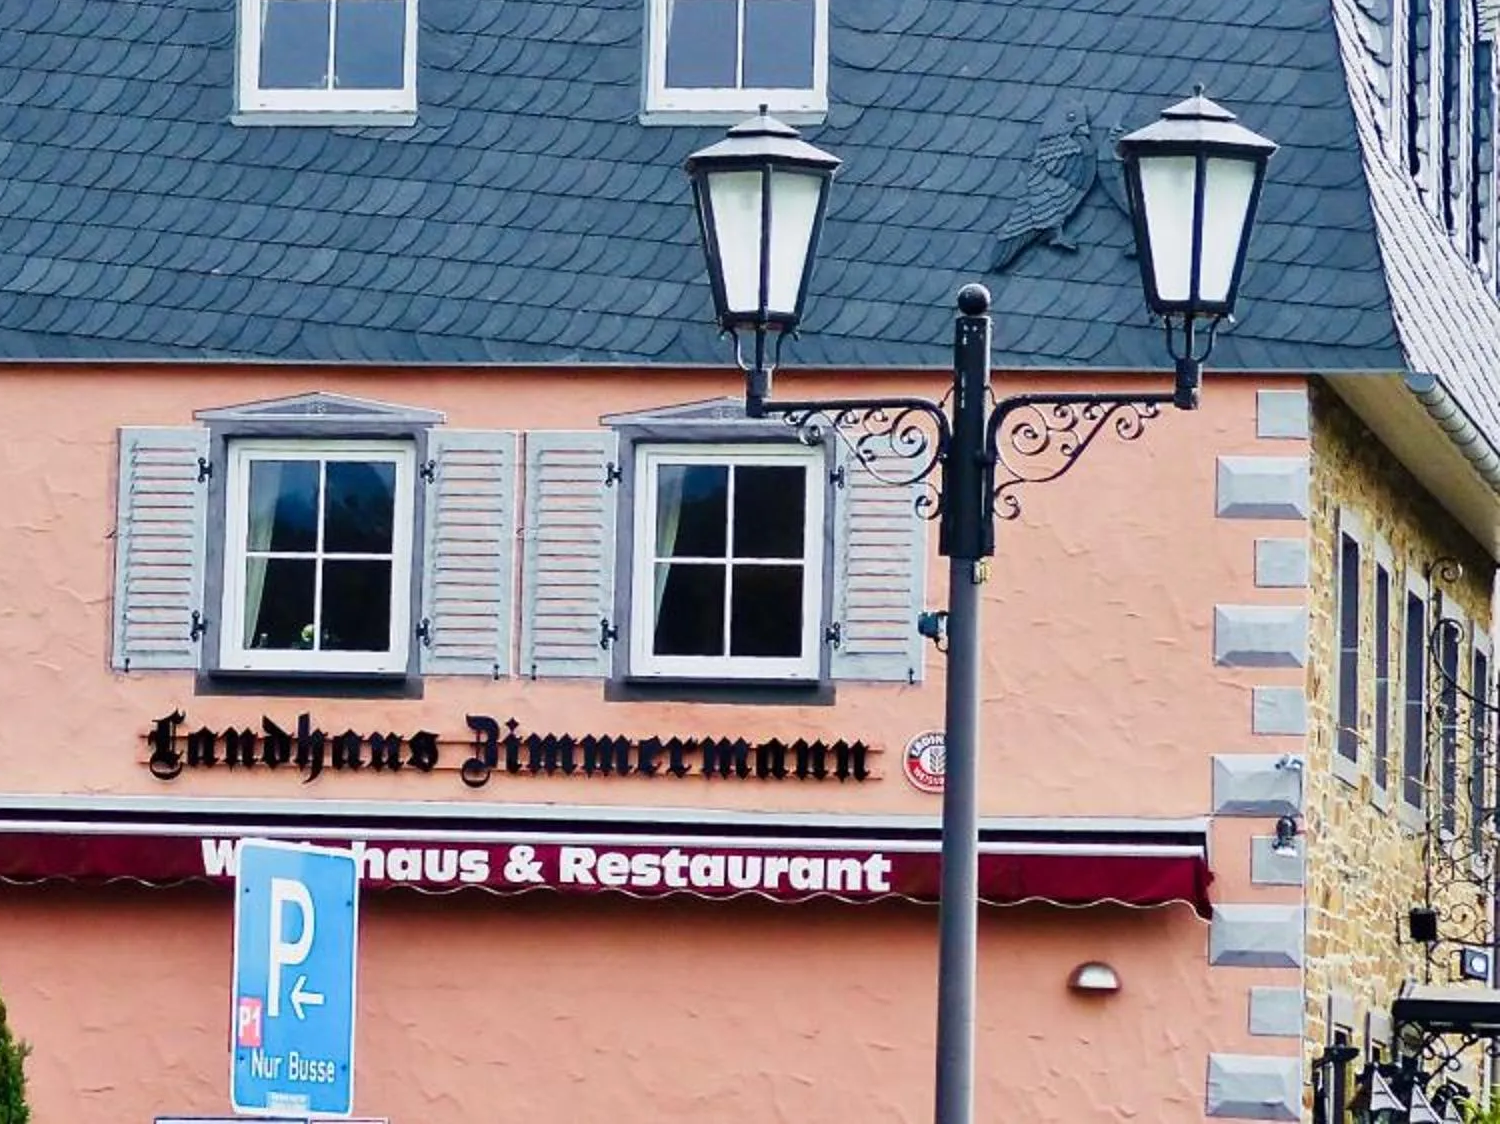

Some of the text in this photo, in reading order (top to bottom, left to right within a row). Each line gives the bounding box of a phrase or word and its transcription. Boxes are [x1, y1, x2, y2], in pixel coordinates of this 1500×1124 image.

[149, 709, 870, 788] Landhaus Zimmermann
[503, 845, 545, 884] &
[559, 846, 892, 892] Restaurant
[266, 876, 316, 1018] P
[237, 1004, 262, 1039] P1
[250, 1047, 336, 1085] Nur Busse
